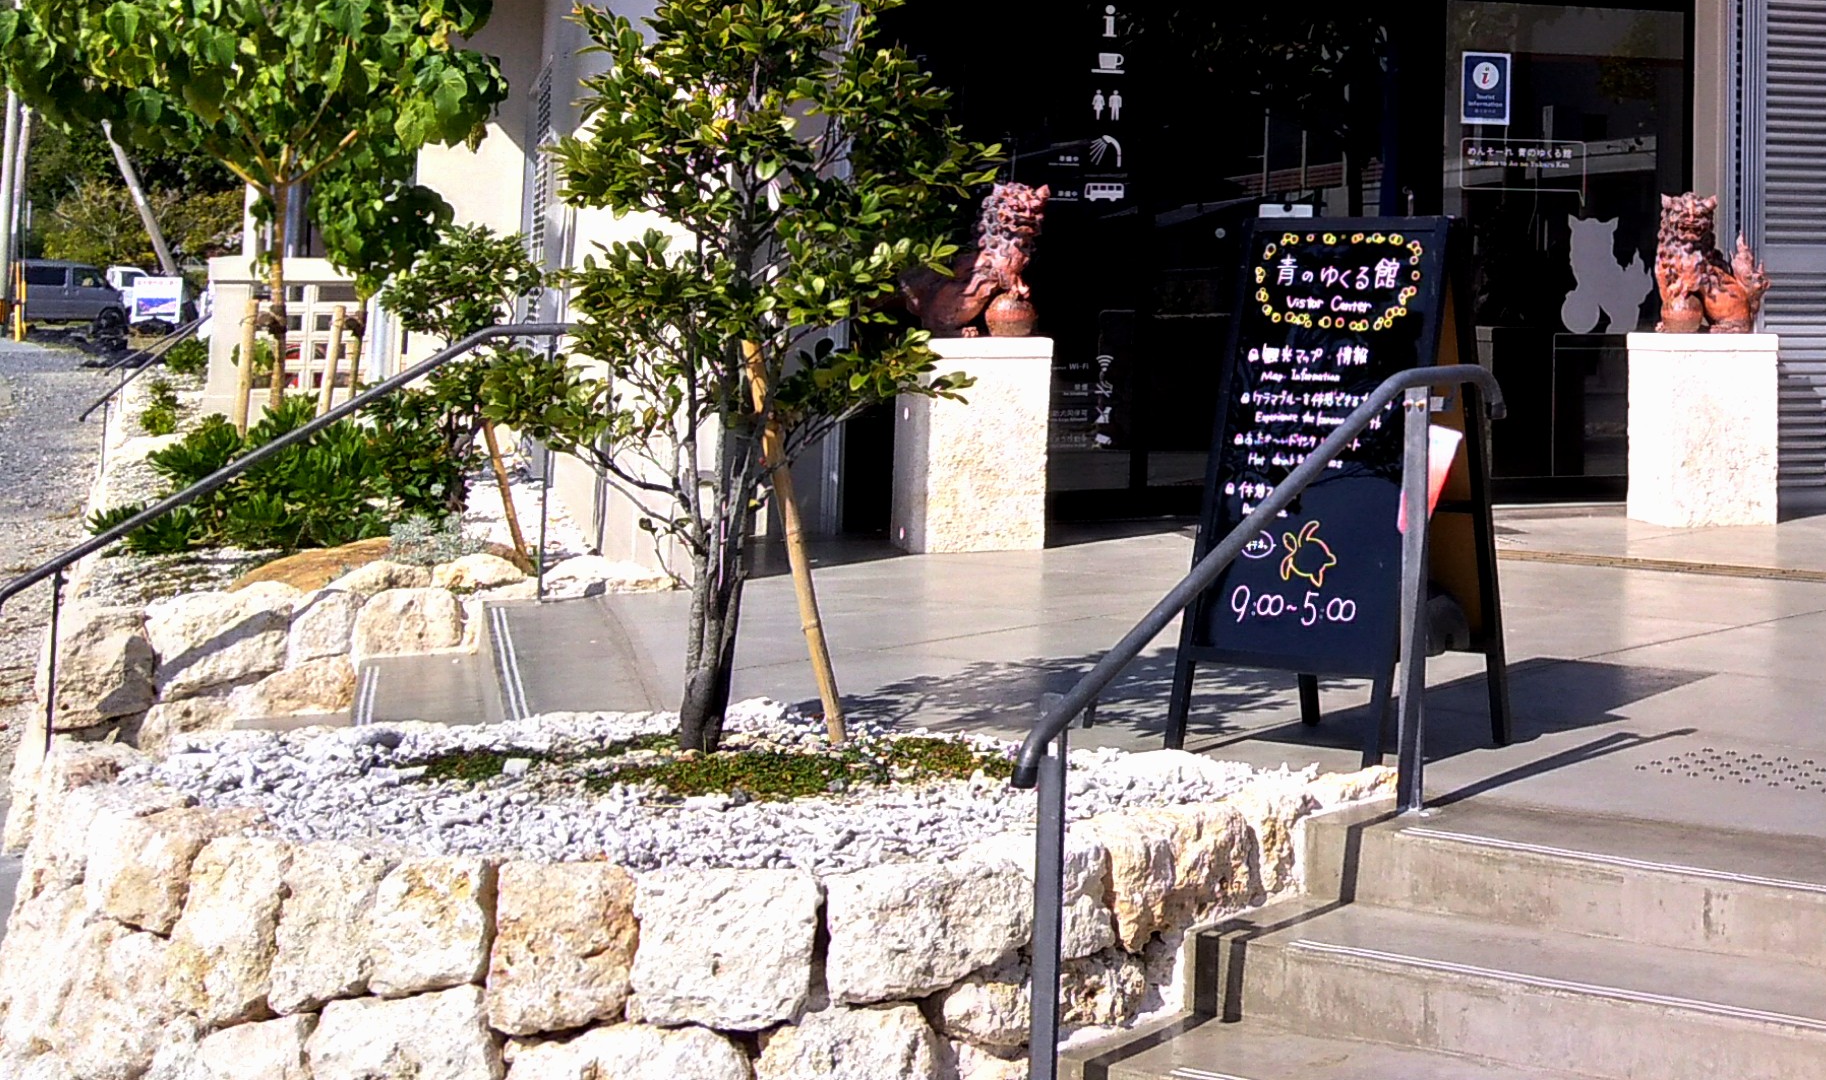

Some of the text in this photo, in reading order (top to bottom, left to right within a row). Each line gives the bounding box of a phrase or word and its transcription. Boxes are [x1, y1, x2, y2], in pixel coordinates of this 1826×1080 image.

[1467, 146, 1573, 159] めんそーれ 青のゆくる館
[1276, 253, 1401, 291] 青のゆくる館
[1330, 295, 1373, 313] Center
[1069, 362, 1090, 371] Wi-Fi
[1248, 452, 1266, 467] Hot
